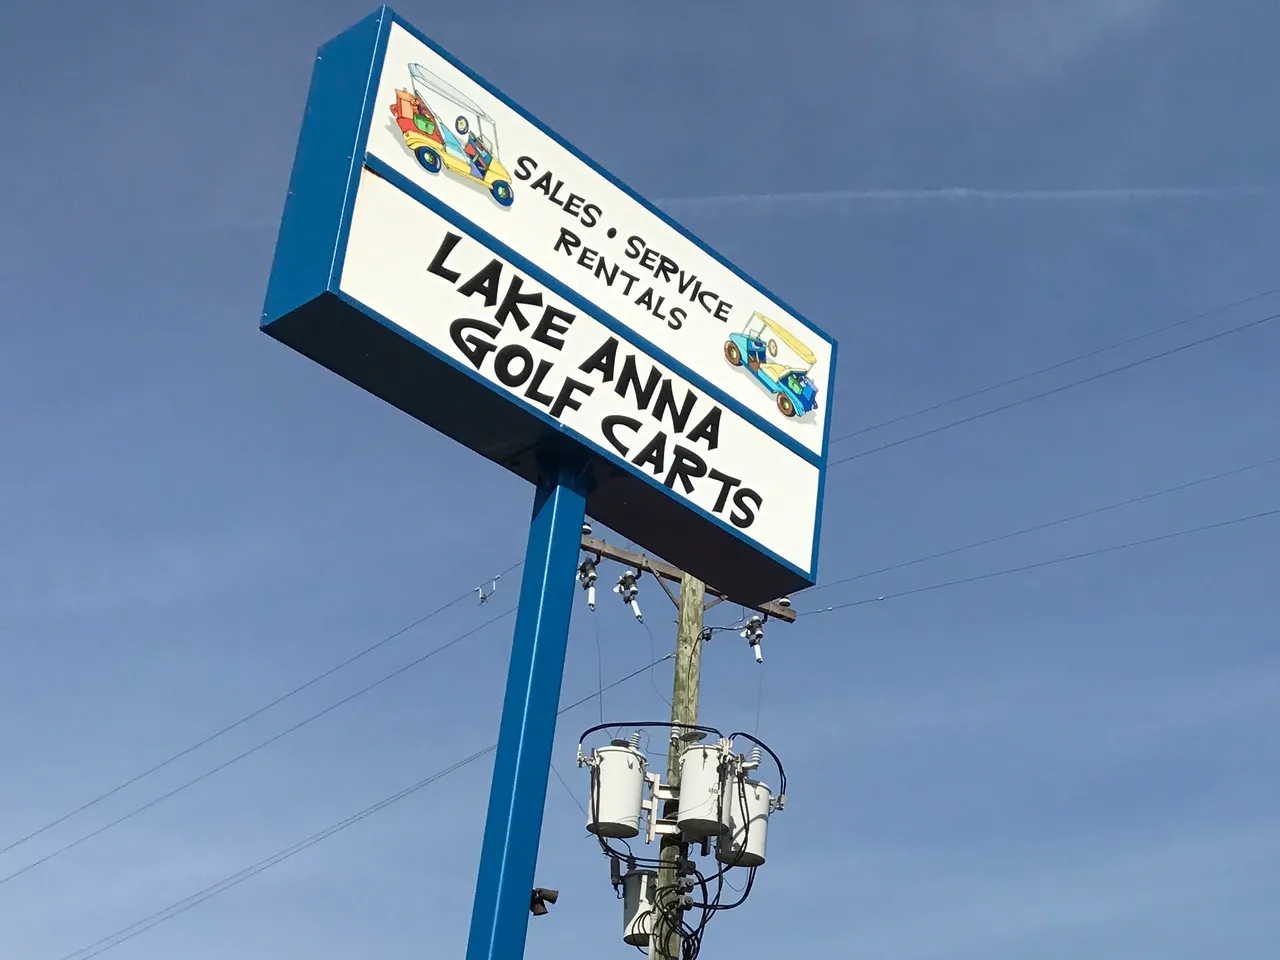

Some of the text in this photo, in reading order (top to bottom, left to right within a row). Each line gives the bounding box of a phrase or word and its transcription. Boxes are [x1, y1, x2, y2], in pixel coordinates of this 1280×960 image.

[514, 155, 734, 323] SALES SERVICE
[553, 226, 688, 330] RENTALS
[426, 230, 722, 450] LAKE ANNA
[449, 317, 763, 529] GOLF CARTS
